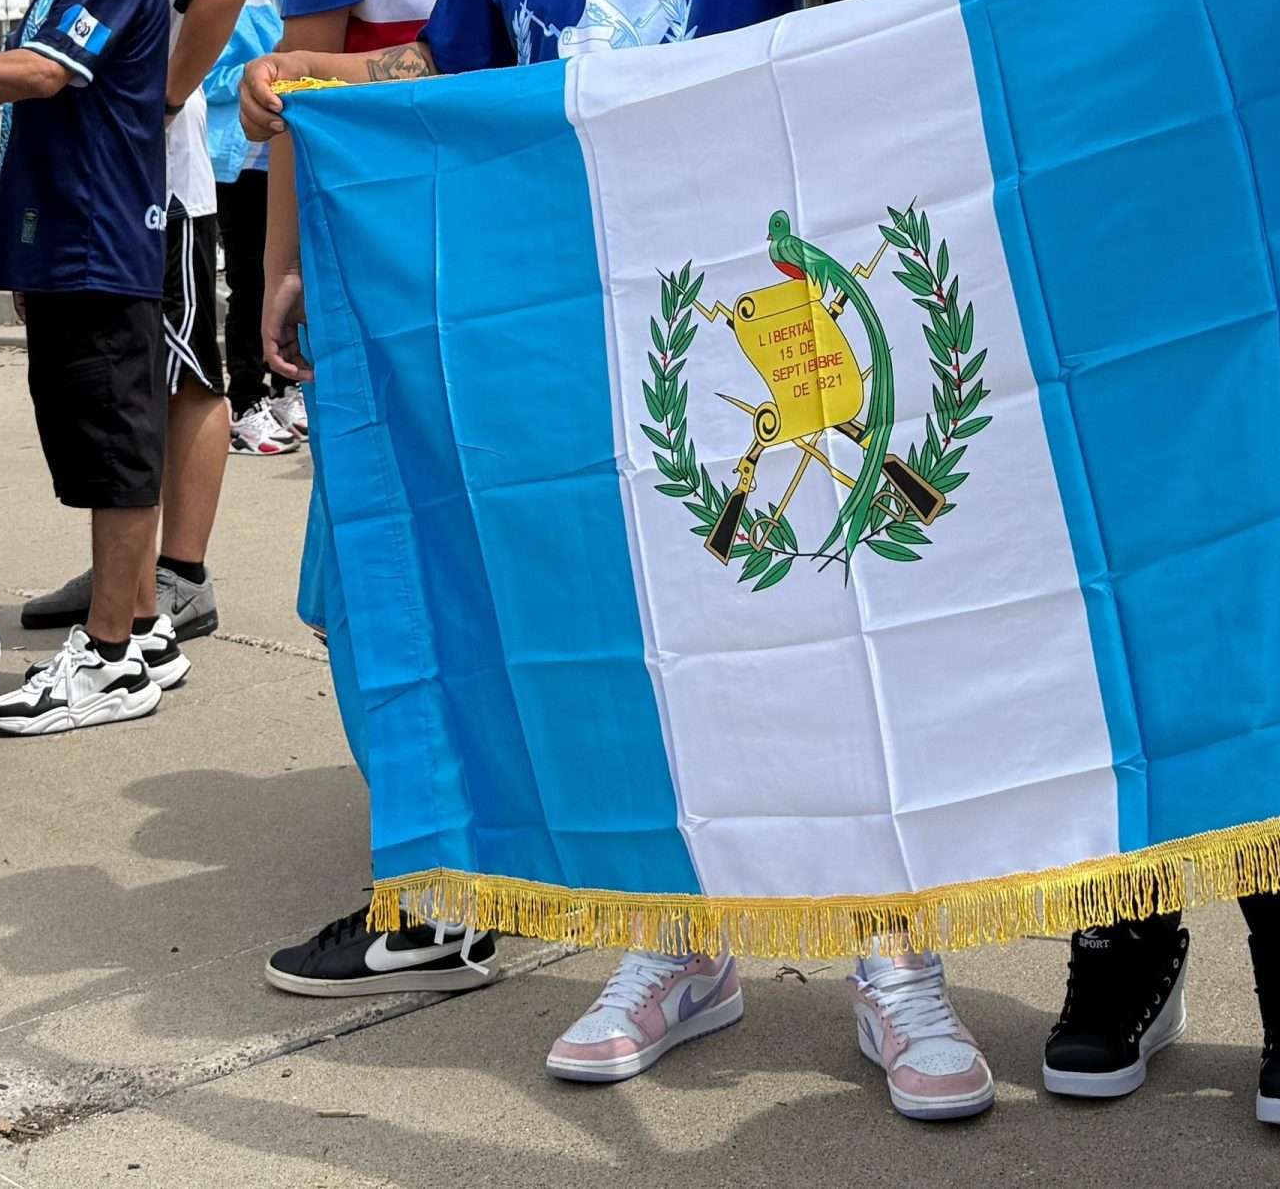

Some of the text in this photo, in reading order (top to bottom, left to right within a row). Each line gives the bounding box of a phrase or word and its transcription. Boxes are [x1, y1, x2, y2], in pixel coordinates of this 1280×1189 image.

[758, 319, 815, 347] LIBERTAD
[780, 339, 816, 361] 15 DE
[793, 382, 811, 398] DE
[1079, 938, 1110, 949] SPORT
